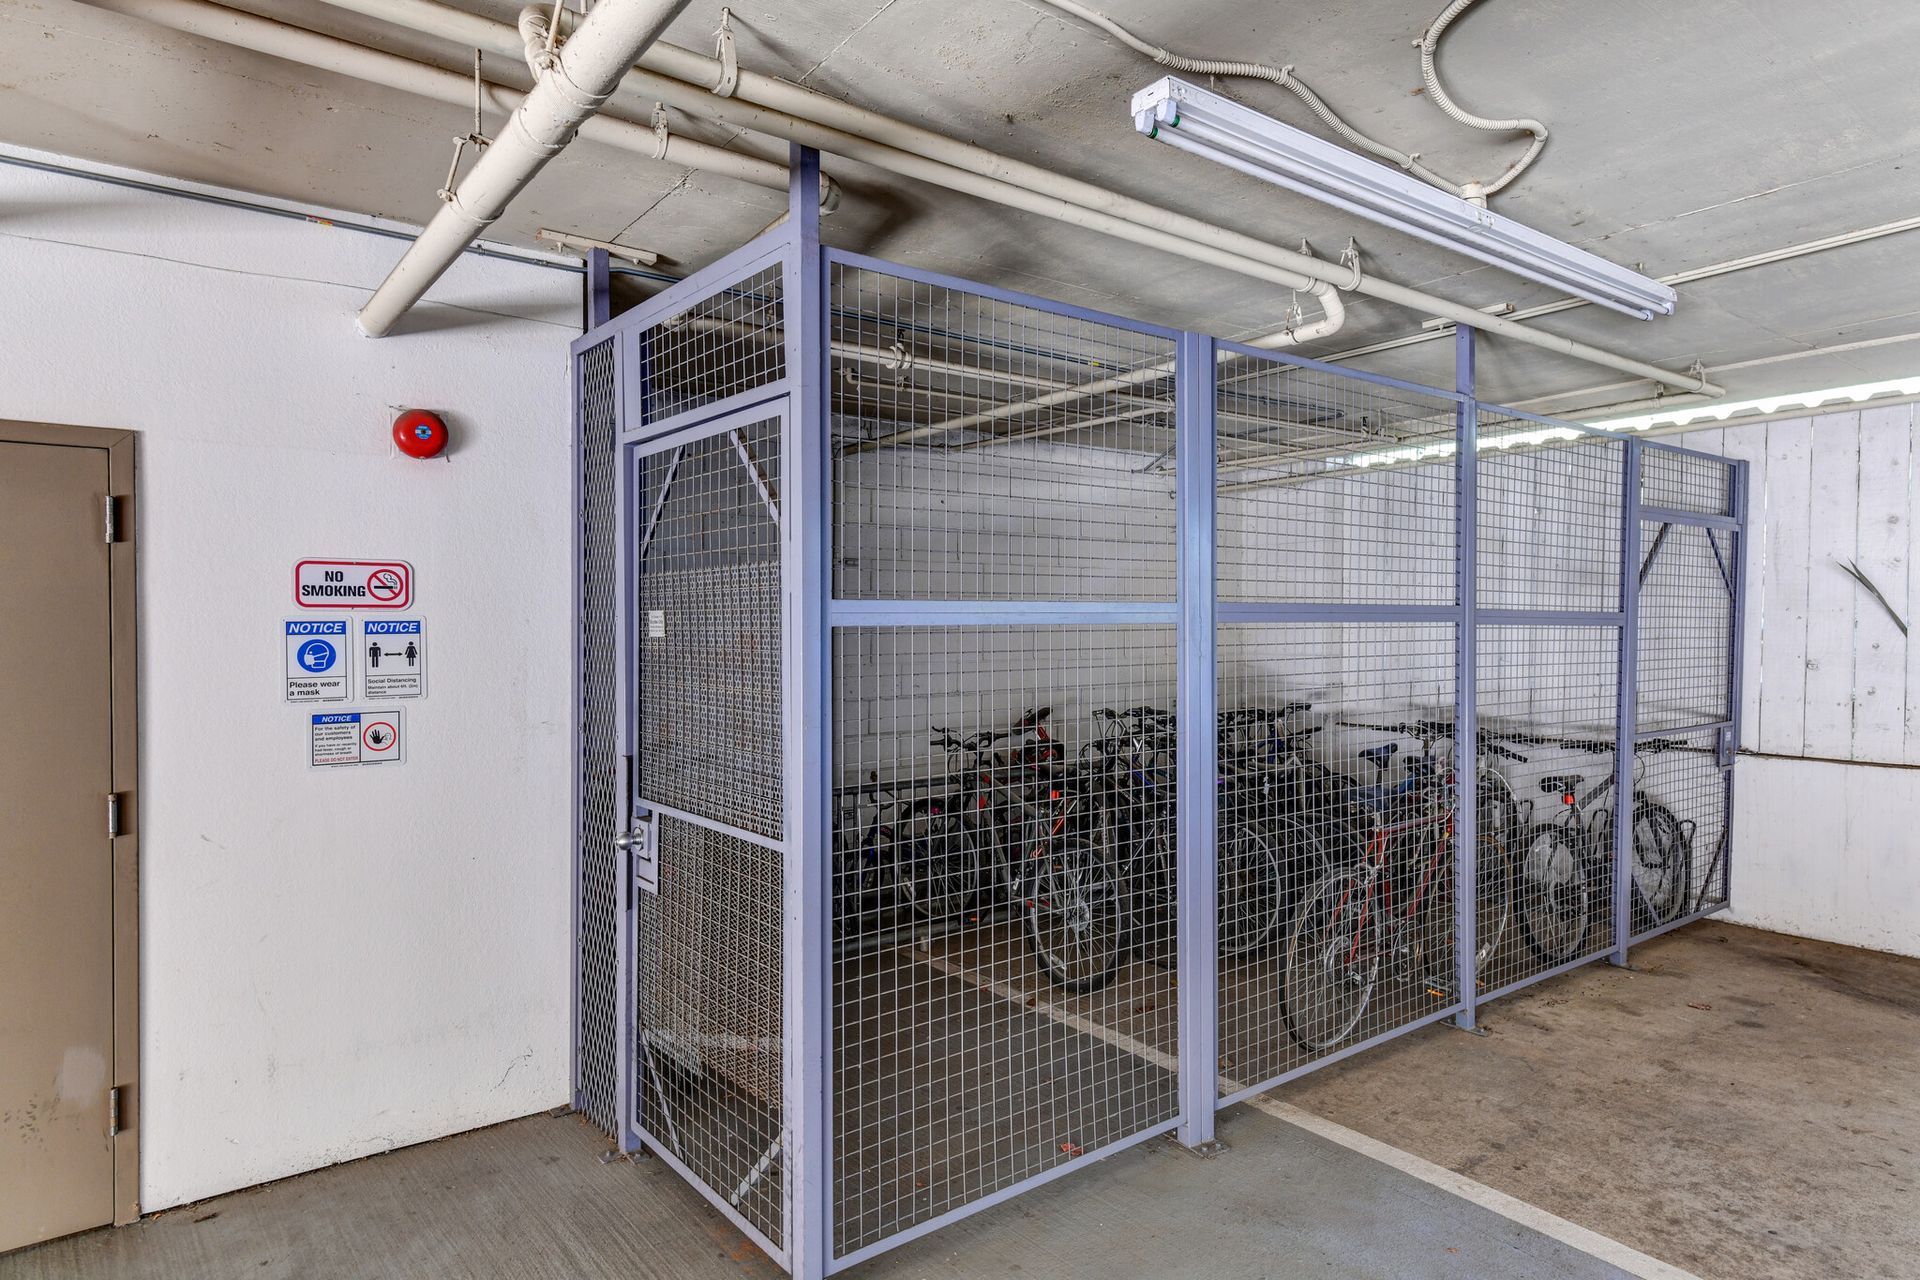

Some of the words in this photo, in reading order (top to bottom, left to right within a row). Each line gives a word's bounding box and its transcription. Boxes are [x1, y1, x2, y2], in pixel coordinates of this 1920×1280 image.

[324, 570, 344, 582] NO
[301, 584, 366, 597] SMOKING
[288, 623, 343, 633] NOTICE
[367, 622, 418, 633] NOTICE
[289, 681, 318, 689] Please
[297, 688, 321, 696] mask
